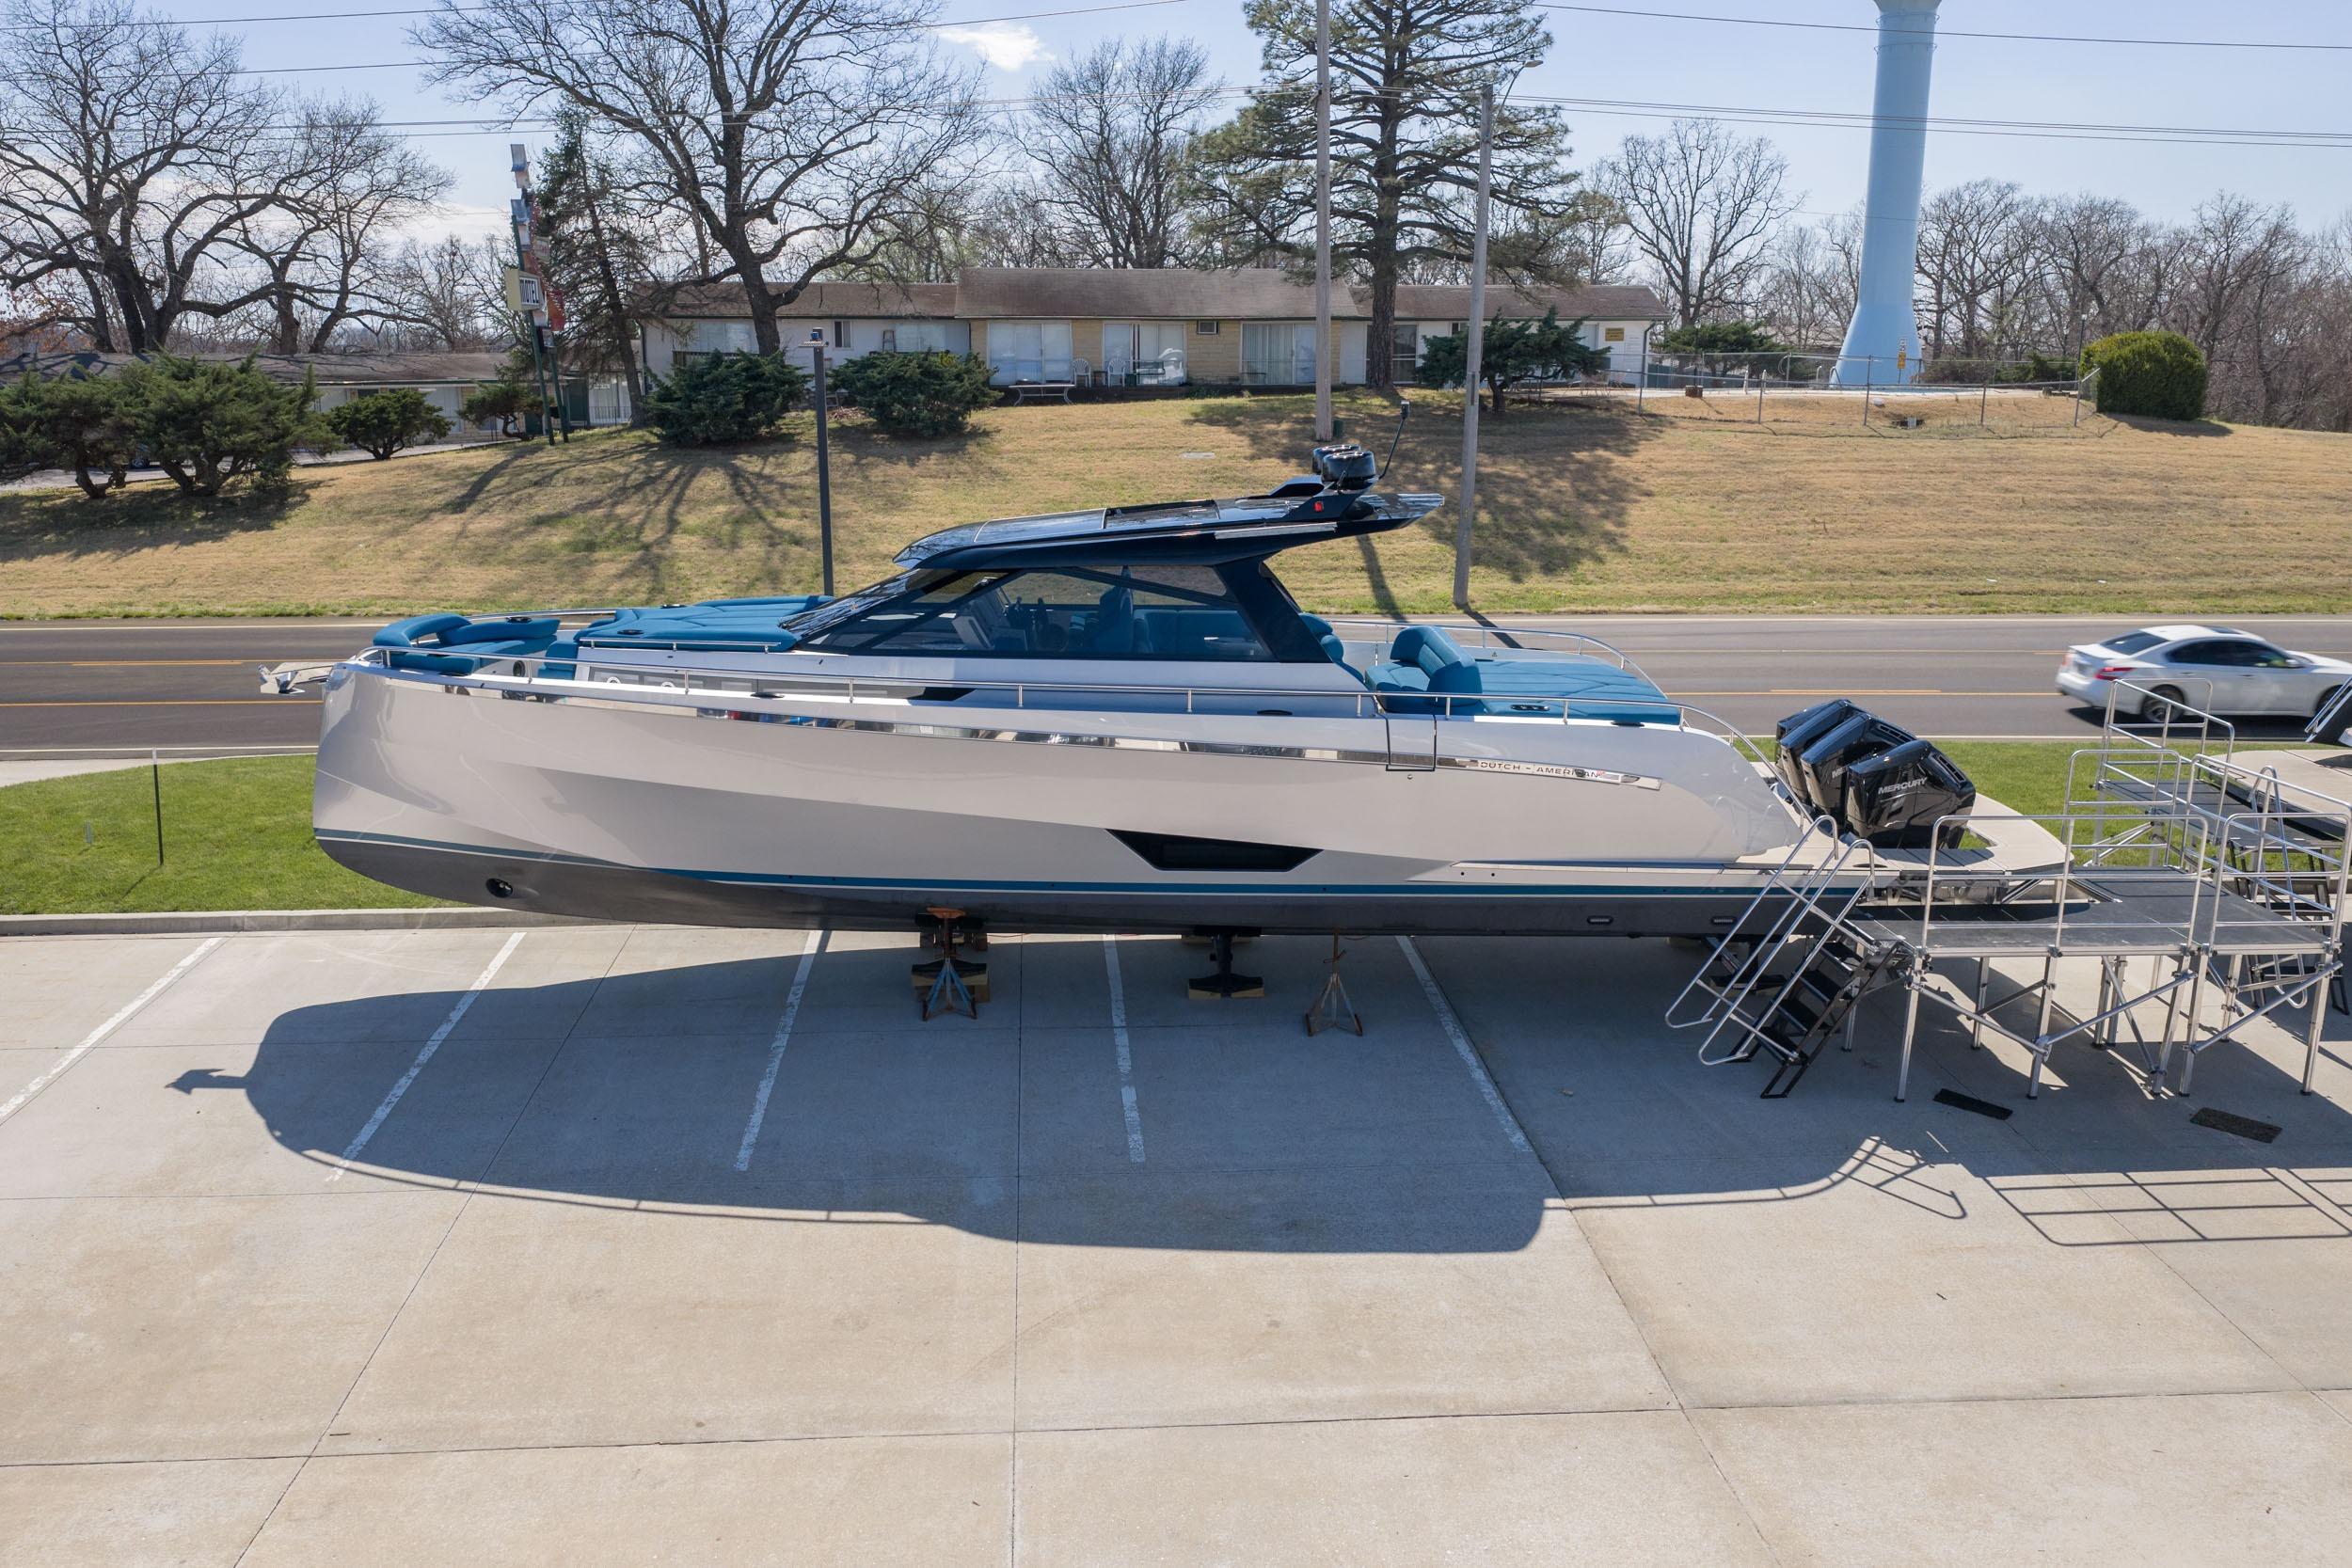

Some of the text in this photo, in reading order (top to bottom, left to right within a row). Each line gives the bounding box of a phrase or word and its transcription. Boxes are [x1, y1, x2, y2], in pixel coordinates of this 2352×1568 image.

[1480, 761, 1520, 769] DUTCH
[1536, 767, 1598, 778] AMERIAN
[1878, 777, 1927, 794] MERCURY
